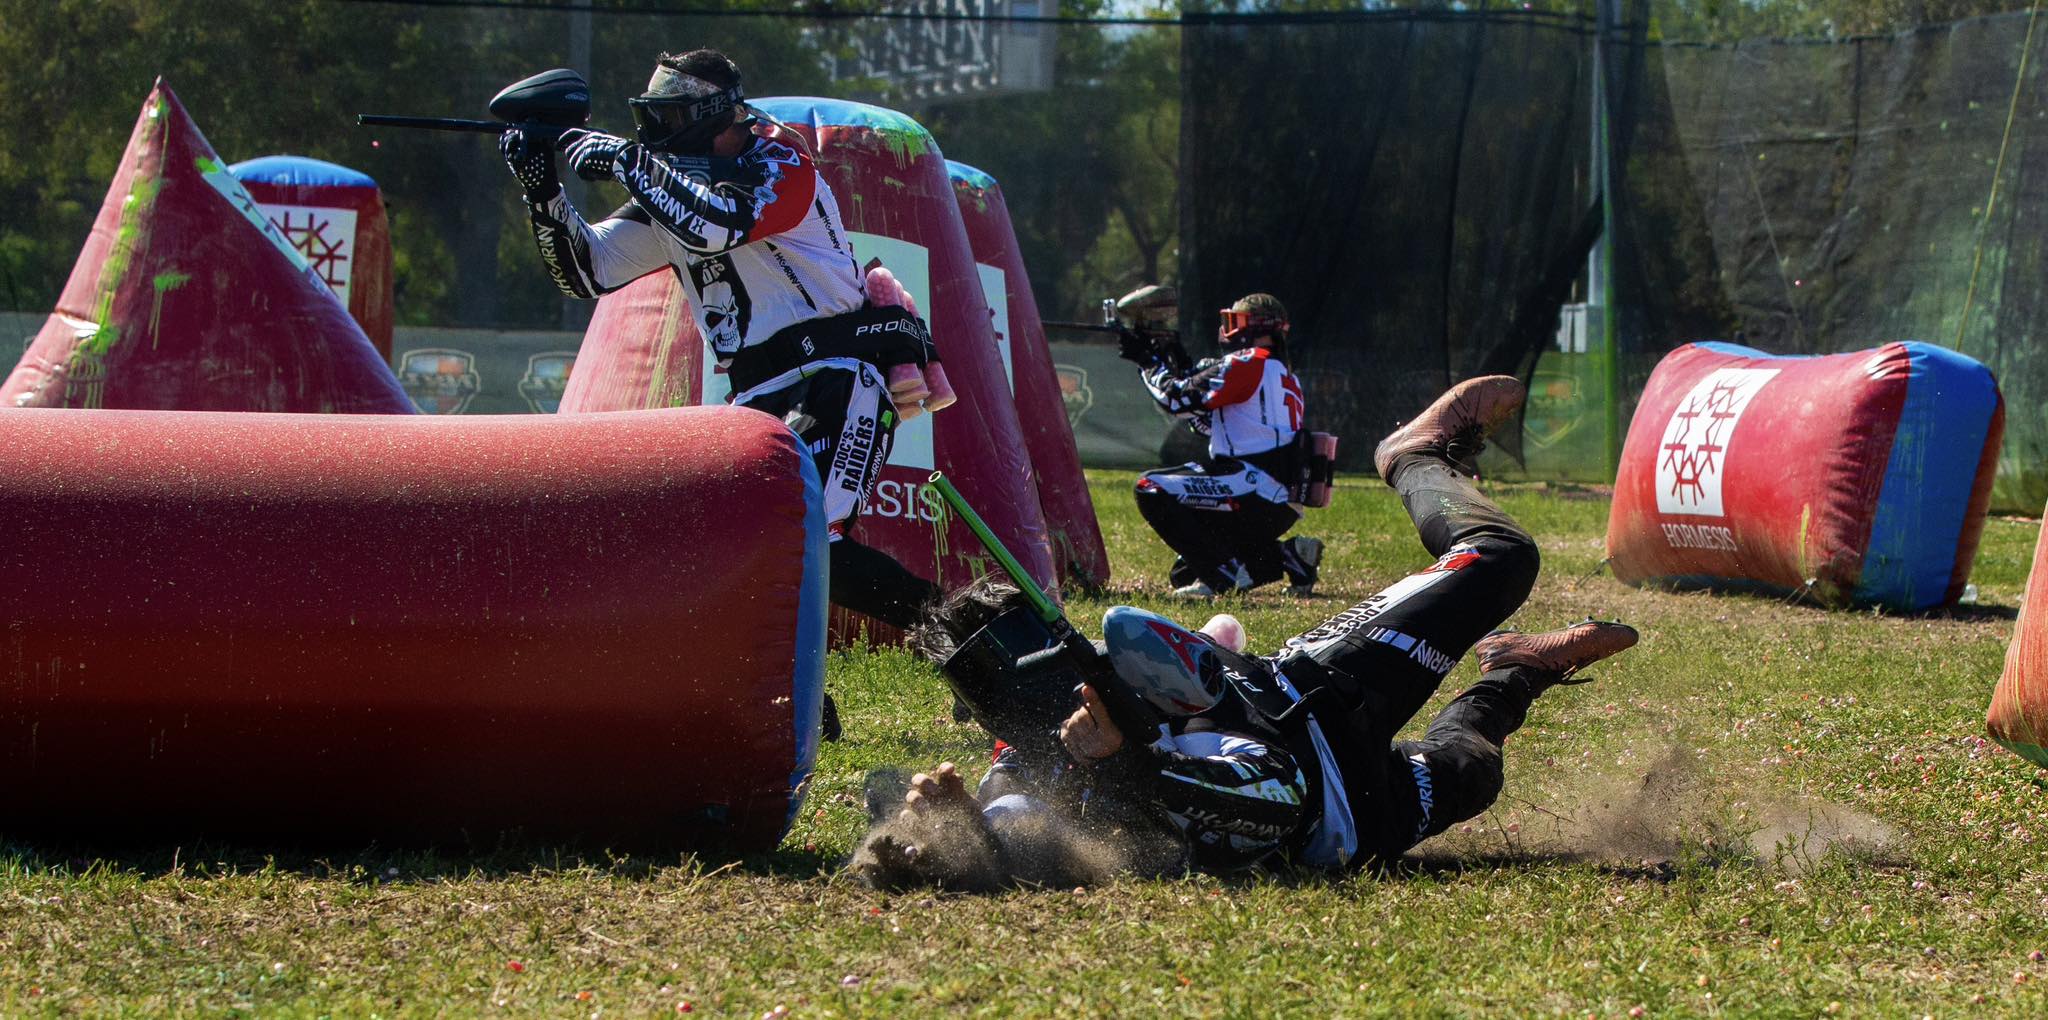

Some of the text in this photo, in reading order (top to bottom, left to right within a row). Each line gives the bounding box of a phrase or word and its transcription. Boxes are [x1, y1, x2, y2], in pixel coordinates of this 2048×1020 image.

[841, 415, 875, 493] RAIDERS
[861, 480, 943, 521] SIS
[1661, 523, 1738, 552] HORMESIS
